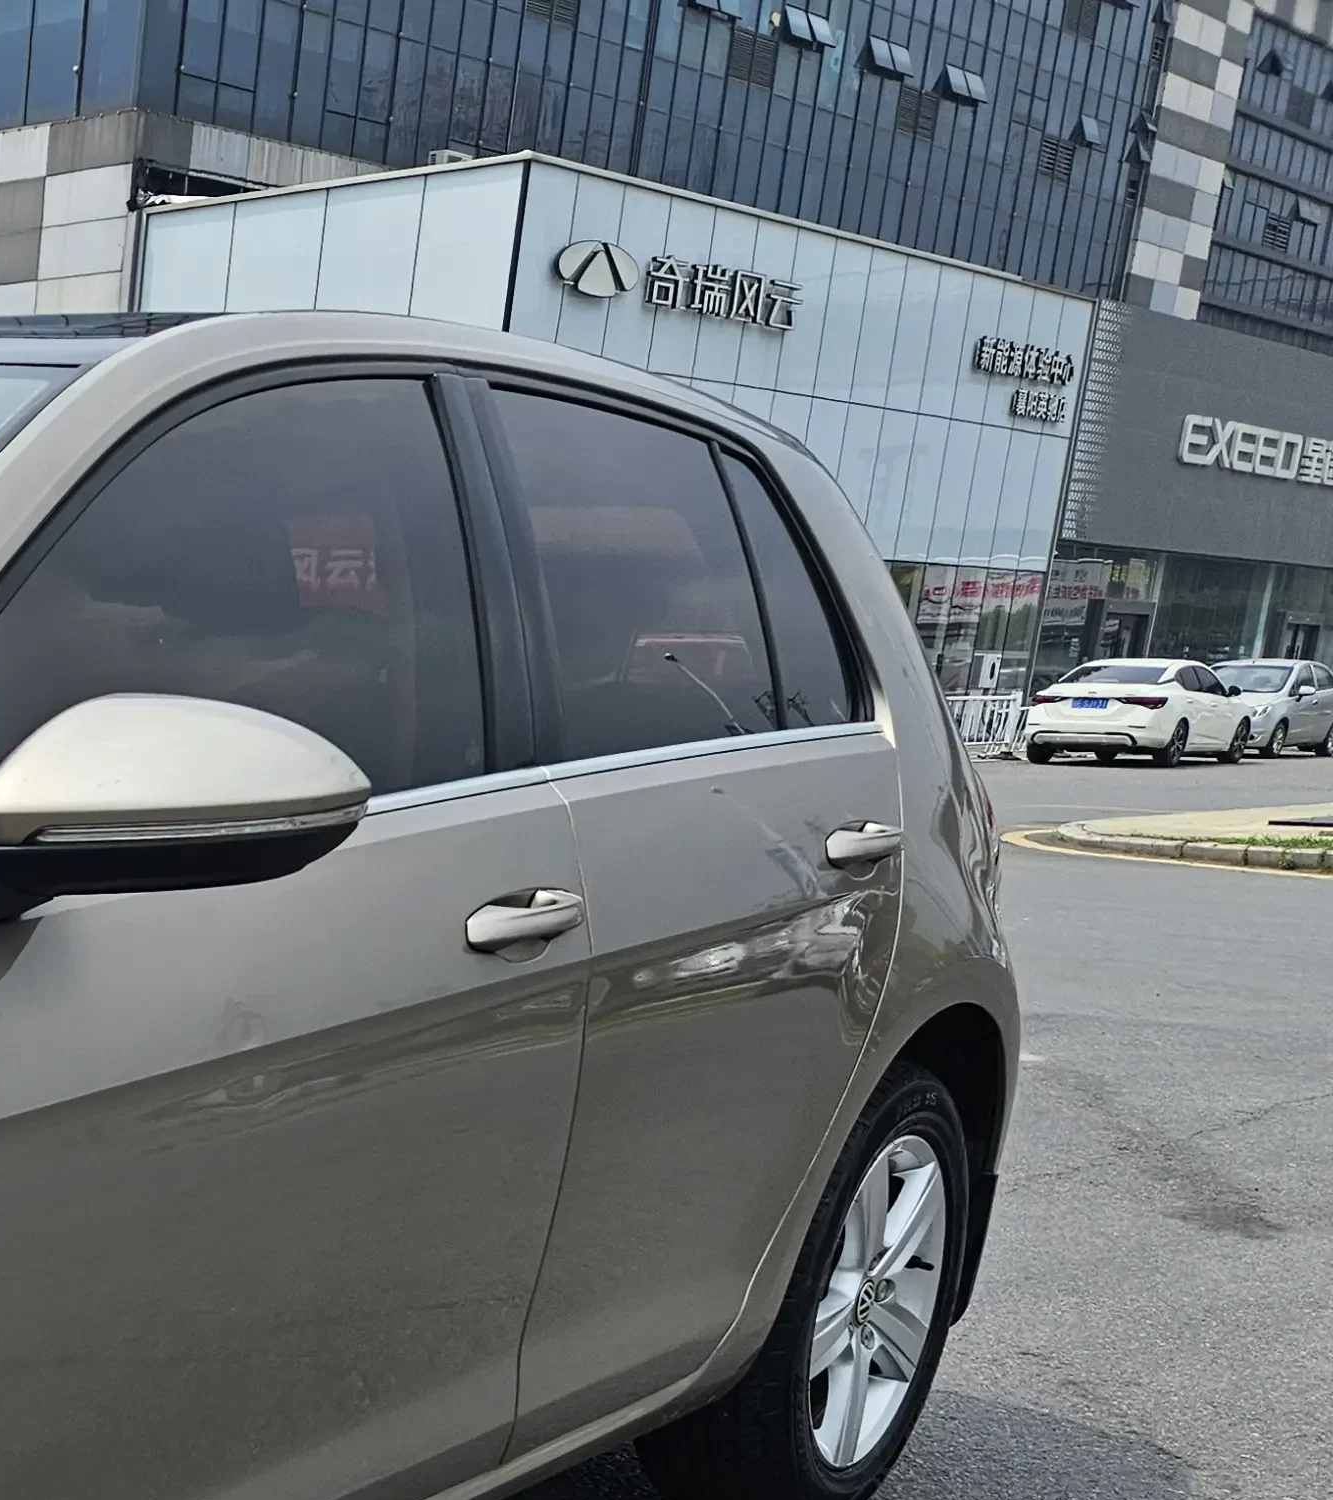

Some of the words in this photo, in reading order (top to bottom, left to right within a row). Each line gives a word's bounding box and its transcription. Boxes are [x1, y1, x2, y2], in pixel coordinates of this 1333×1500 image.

[645, 255, 804, 330] 奇瑞风云
[977, 337, 1073, 385] 新能源体验中心
[1179, 414, 1303, 480] EXEED
